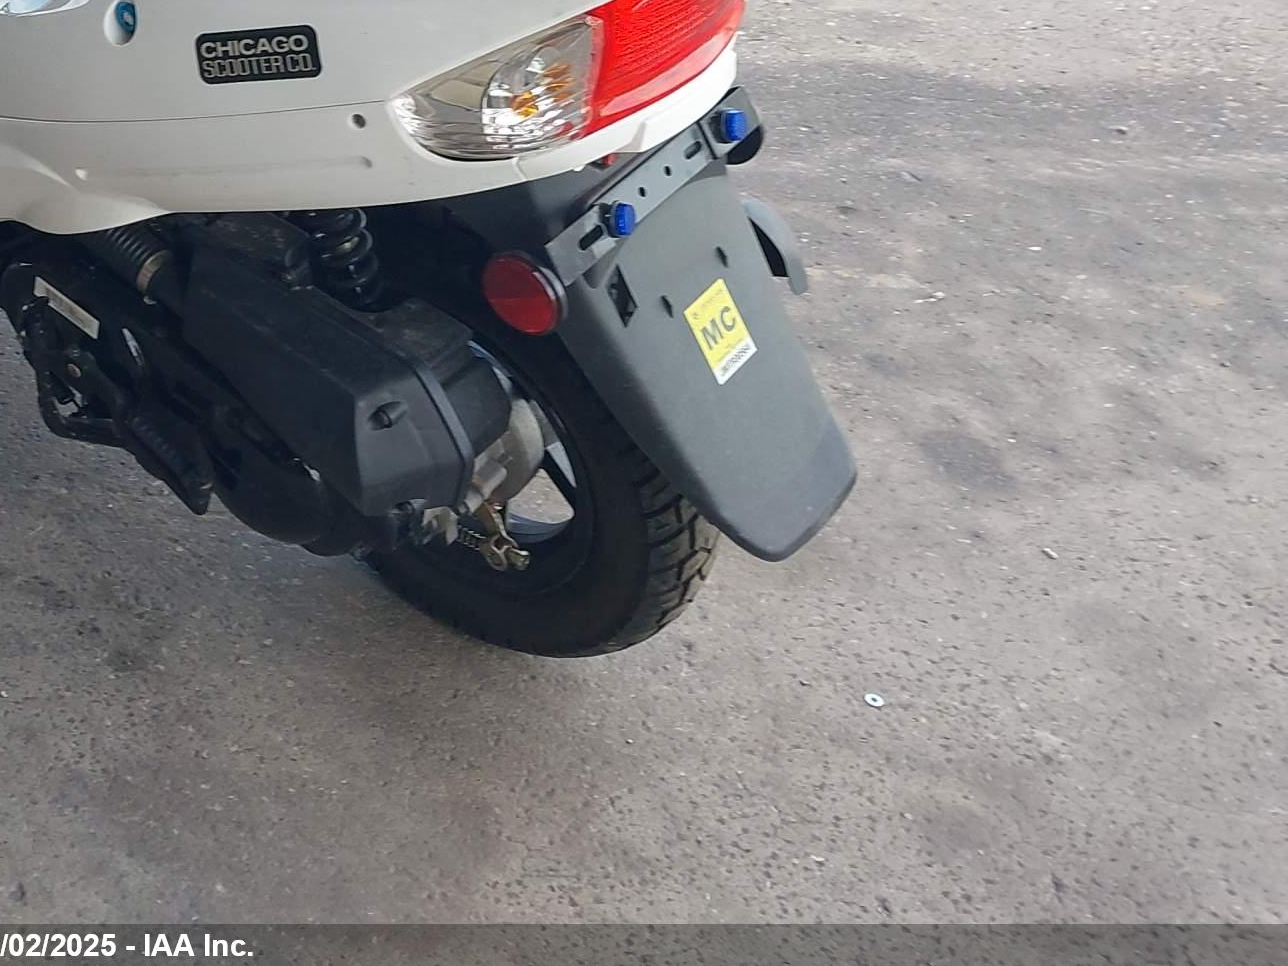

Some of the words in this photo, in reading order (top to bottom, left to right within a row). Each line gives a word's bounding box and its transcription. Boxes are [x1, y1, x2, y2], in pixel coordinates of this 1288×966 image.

[200, 35, 309, 58] CHICAGO
[202, 55, 285, 78] SCOOTER
[701, 305, 737, 351] MC
